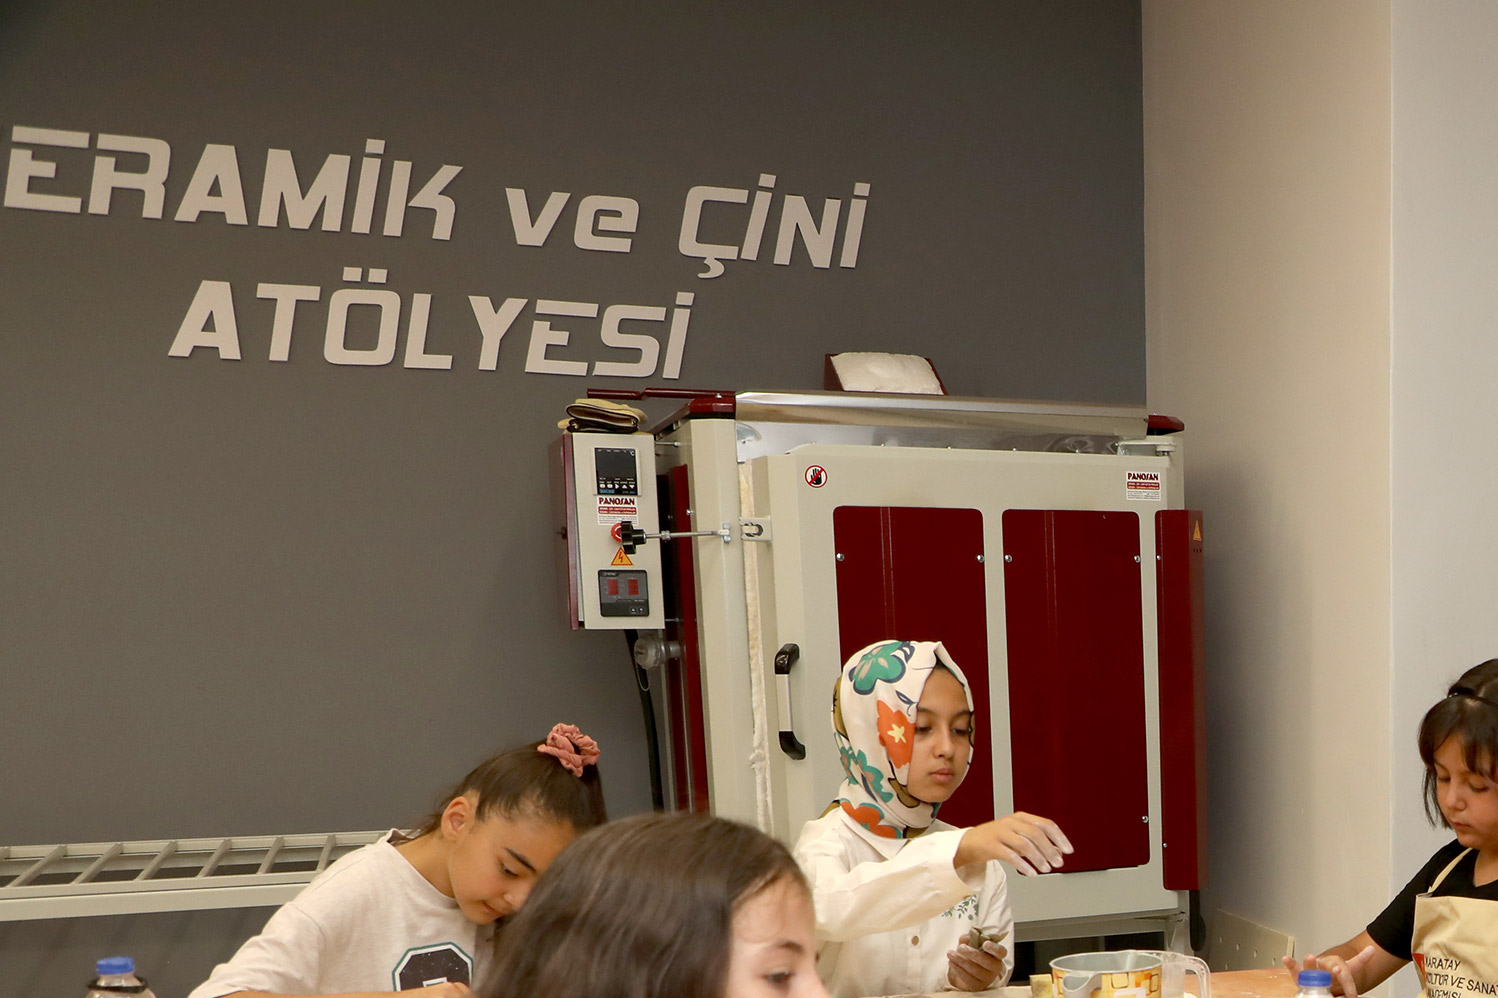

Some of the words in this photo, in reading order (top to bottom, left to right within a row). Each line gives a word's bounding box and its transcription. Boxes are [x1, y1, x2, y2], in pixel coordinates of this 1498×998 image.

[4, 126, 463, 241] ERAMİK
[505, 187, 639, 253] ve
[678, 173, 871, 279] ÇİNİ
[167, 266, 695, 379] ATÖLYESİ
[1127, 472, 1159, 481] PANOSAN
[598, 497, 635, 506] PANOSAN
[1450, 975, 1466, 989] VE
